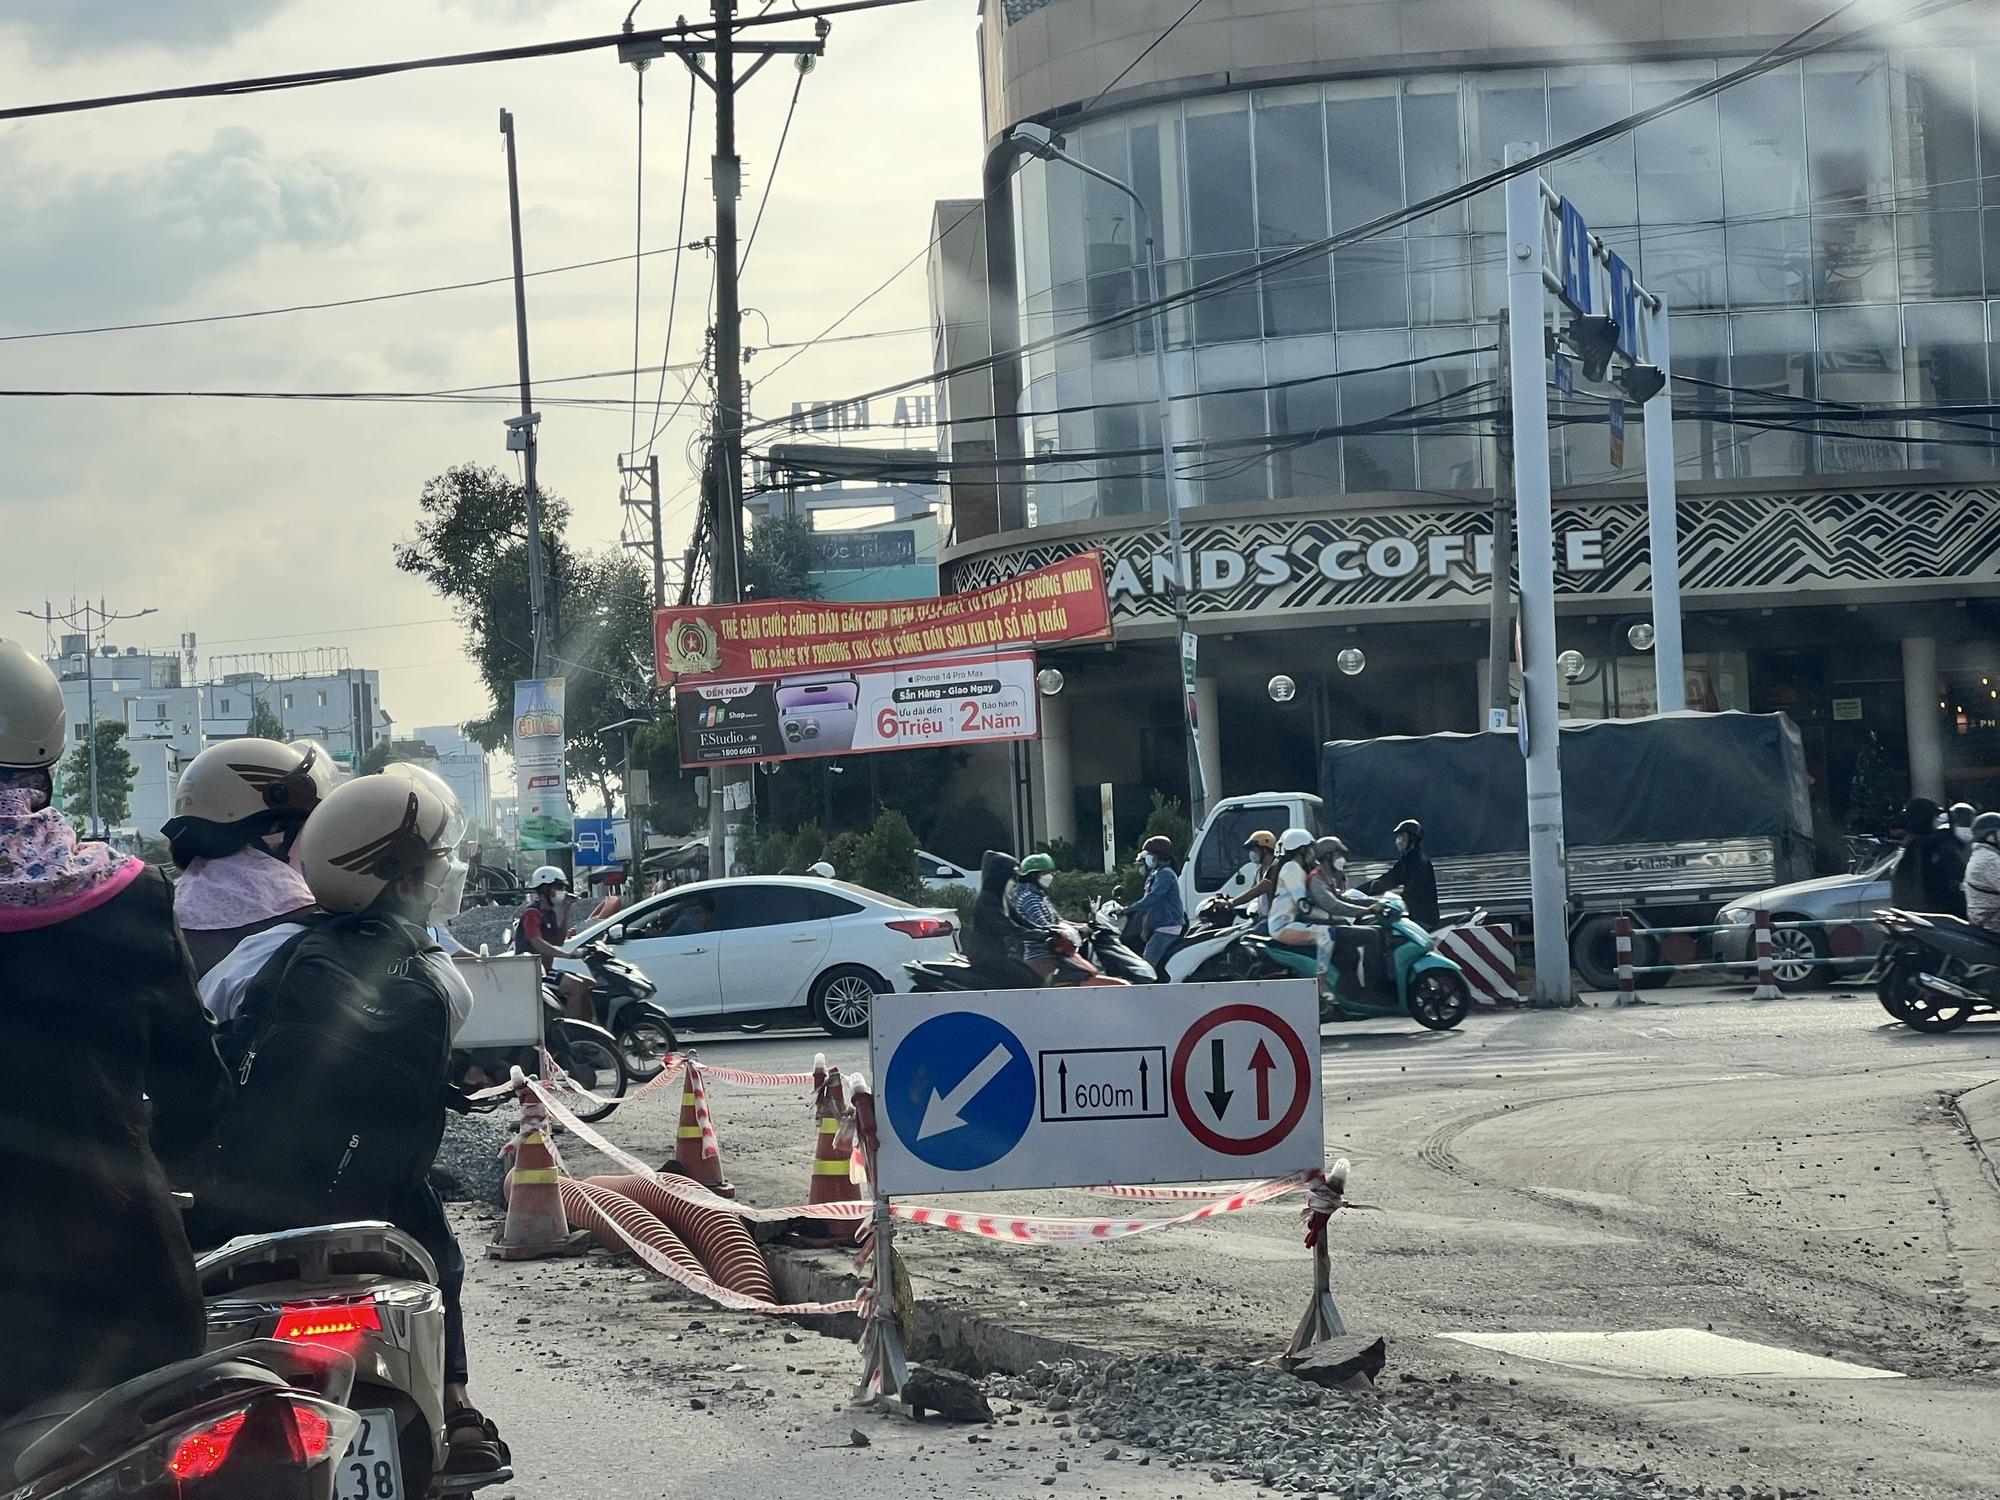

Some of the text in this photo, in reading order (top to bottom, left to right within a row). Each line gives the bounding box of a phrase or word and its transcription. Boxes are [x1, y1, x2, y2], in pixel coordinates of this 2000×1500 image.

[1108, 530, 1604, 598] ANDS COFFE
[721, 612, 739, 640] THẺ
[741, 614, 761, 639] CĂN
[762, 611, 787, 638] CƯỚC
[790, 610, 816, 636] CÔNG
[819, 609, 839, 634] DÂN
[865, 608, 888, 631] CHIP
[1062, 568, 1093, 594] MINH
[872, 633, 895, 658] CỦA
[947, 624, 967, 647] SAU
[968, 622, 987, 645] KHI
[988, 612, 1003, 642] BỎ
[1004, 610, 1019, 639] SỔ
[1037, 600, 1068, 633] KHẨU
[914, 670, 983, 683] iPhone 14 Pro Max
[706, 686, 749, 698] ĐẾN NGAY
[918, 687, 941, 699] Hàng
[948, 686, 968, 696] Giao
[970, 684, 994, 694] Ngay
[899, 707, 911, 717] Ưu
[982, 700, 1018, 710] Bảo hành
[877, 708, 899, 739] 6
[960, 701, 980, 732] 2
[982, 712, 1020, 730] Năm
[899, 718, 943, 739] Triệu
[700, 731, 744, 746] F.Studio
[722, 749, 738, 757] 1800
[739, 747, 756, 755] 6601
[1075, 1084, 1133, 1108] 600m
[334, 1460, 395, 1500] .38
